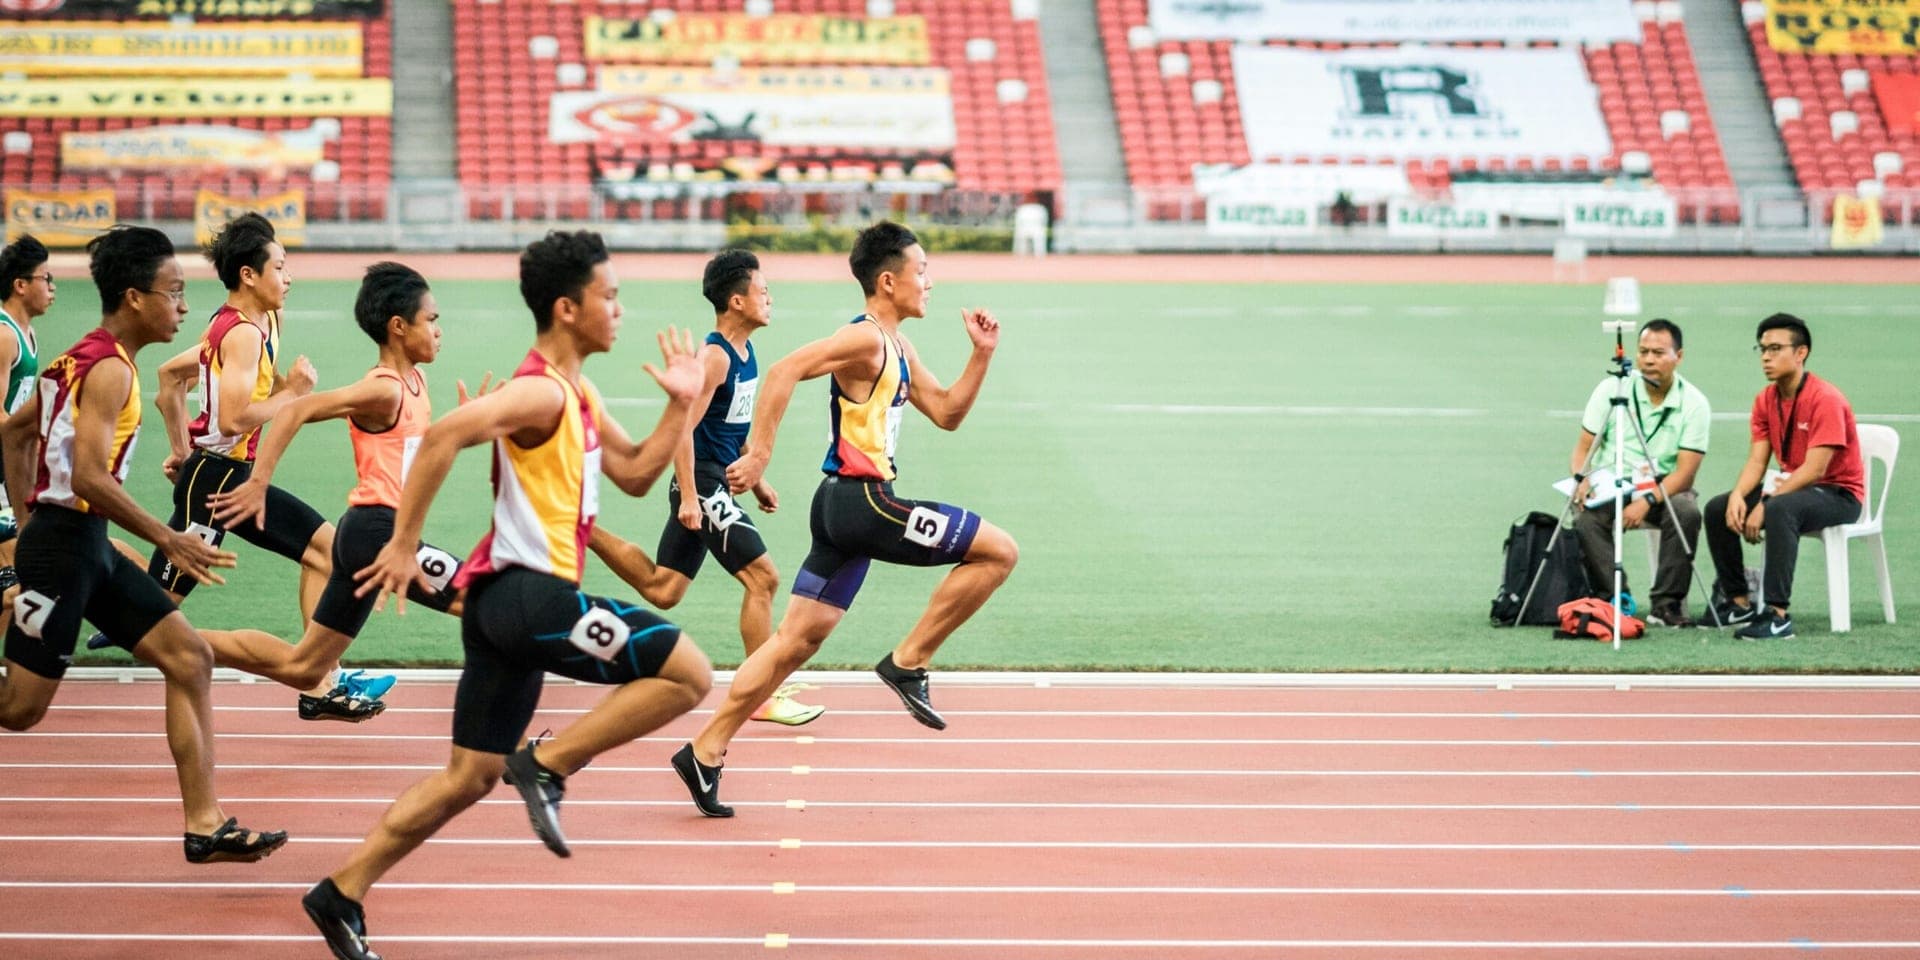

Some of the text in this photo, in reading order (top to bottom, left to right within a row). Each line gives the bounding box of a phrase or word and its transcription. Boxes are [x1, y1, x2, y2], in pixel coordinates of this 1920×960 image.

[1327, 60, 1503, 120] R
[12, 198, 111, 222] CEDAR
[712, 500, 732, 522] 2
[914, 515, 937, 538] 5
[421, 556, 446, 577] 6
[22, 596, 42, 625] 7
[586, 620, 615, 647] 8
